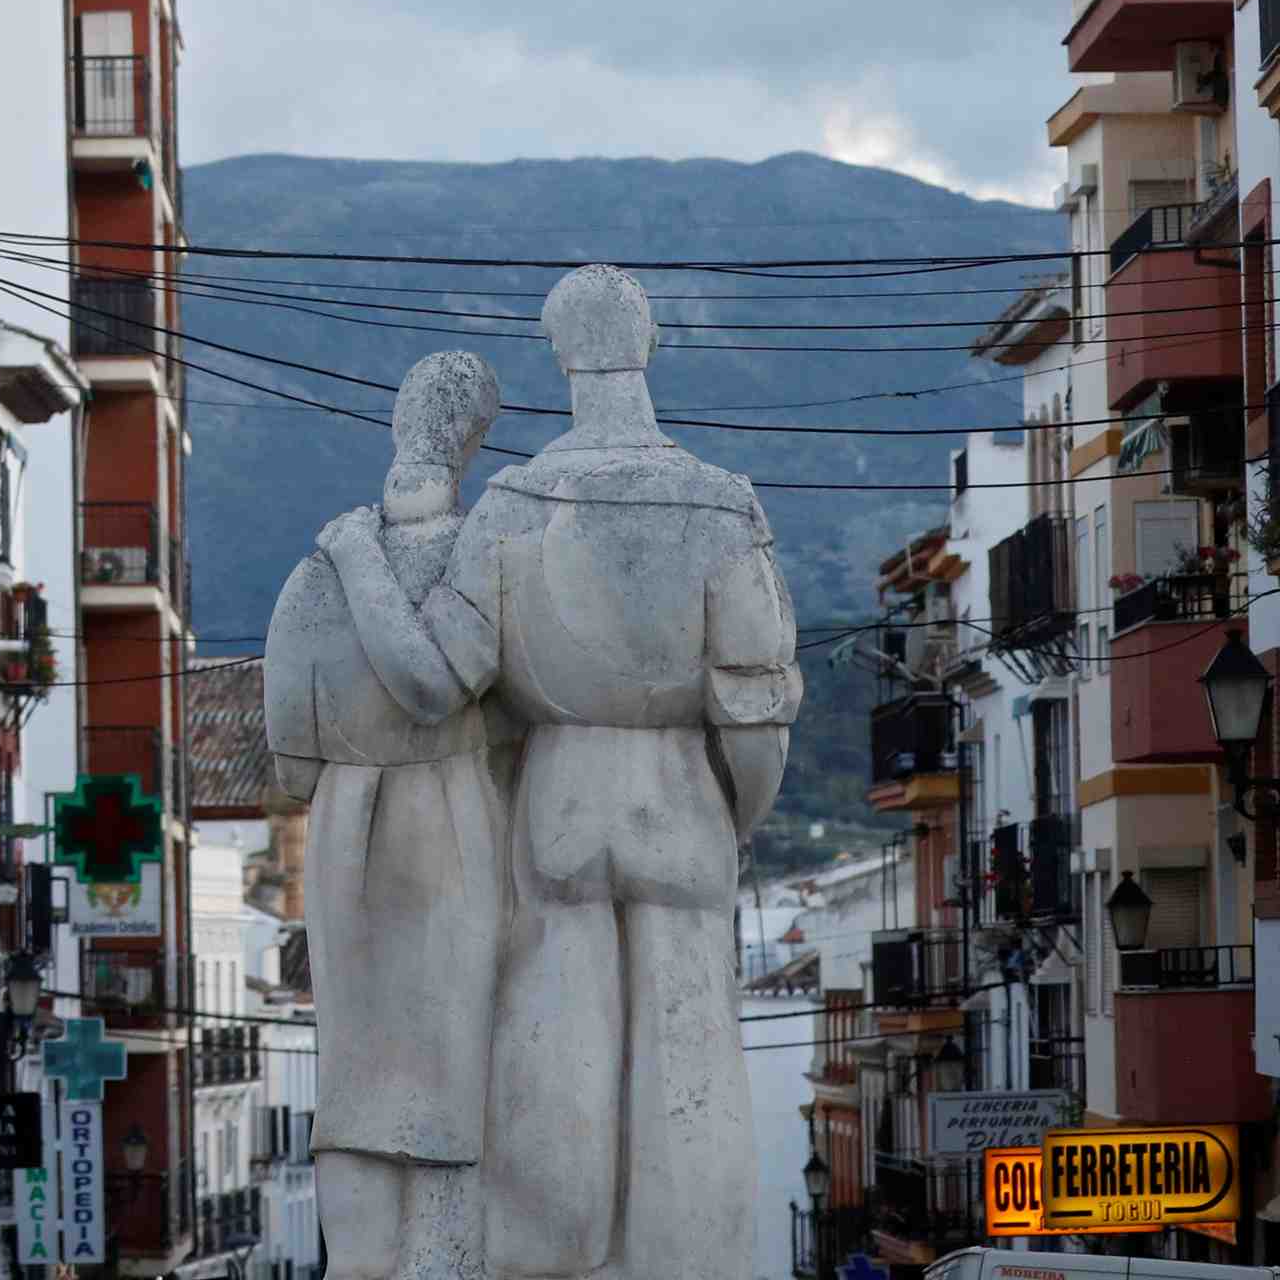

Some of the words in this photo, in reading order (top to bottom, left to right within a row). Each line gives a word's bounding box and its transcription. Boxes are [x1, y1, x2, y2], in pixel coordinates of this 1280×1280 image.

[965, 1128, 1041, 1152] Pilar
[70, 1110, 94, 1257] ORTOPEDIA
[994, 1161, 1043, 1212] COL
[1051, 1141, 1211, 1198] FERRETERIA
[1097, 1199, 1164, 1223] TOGUI
